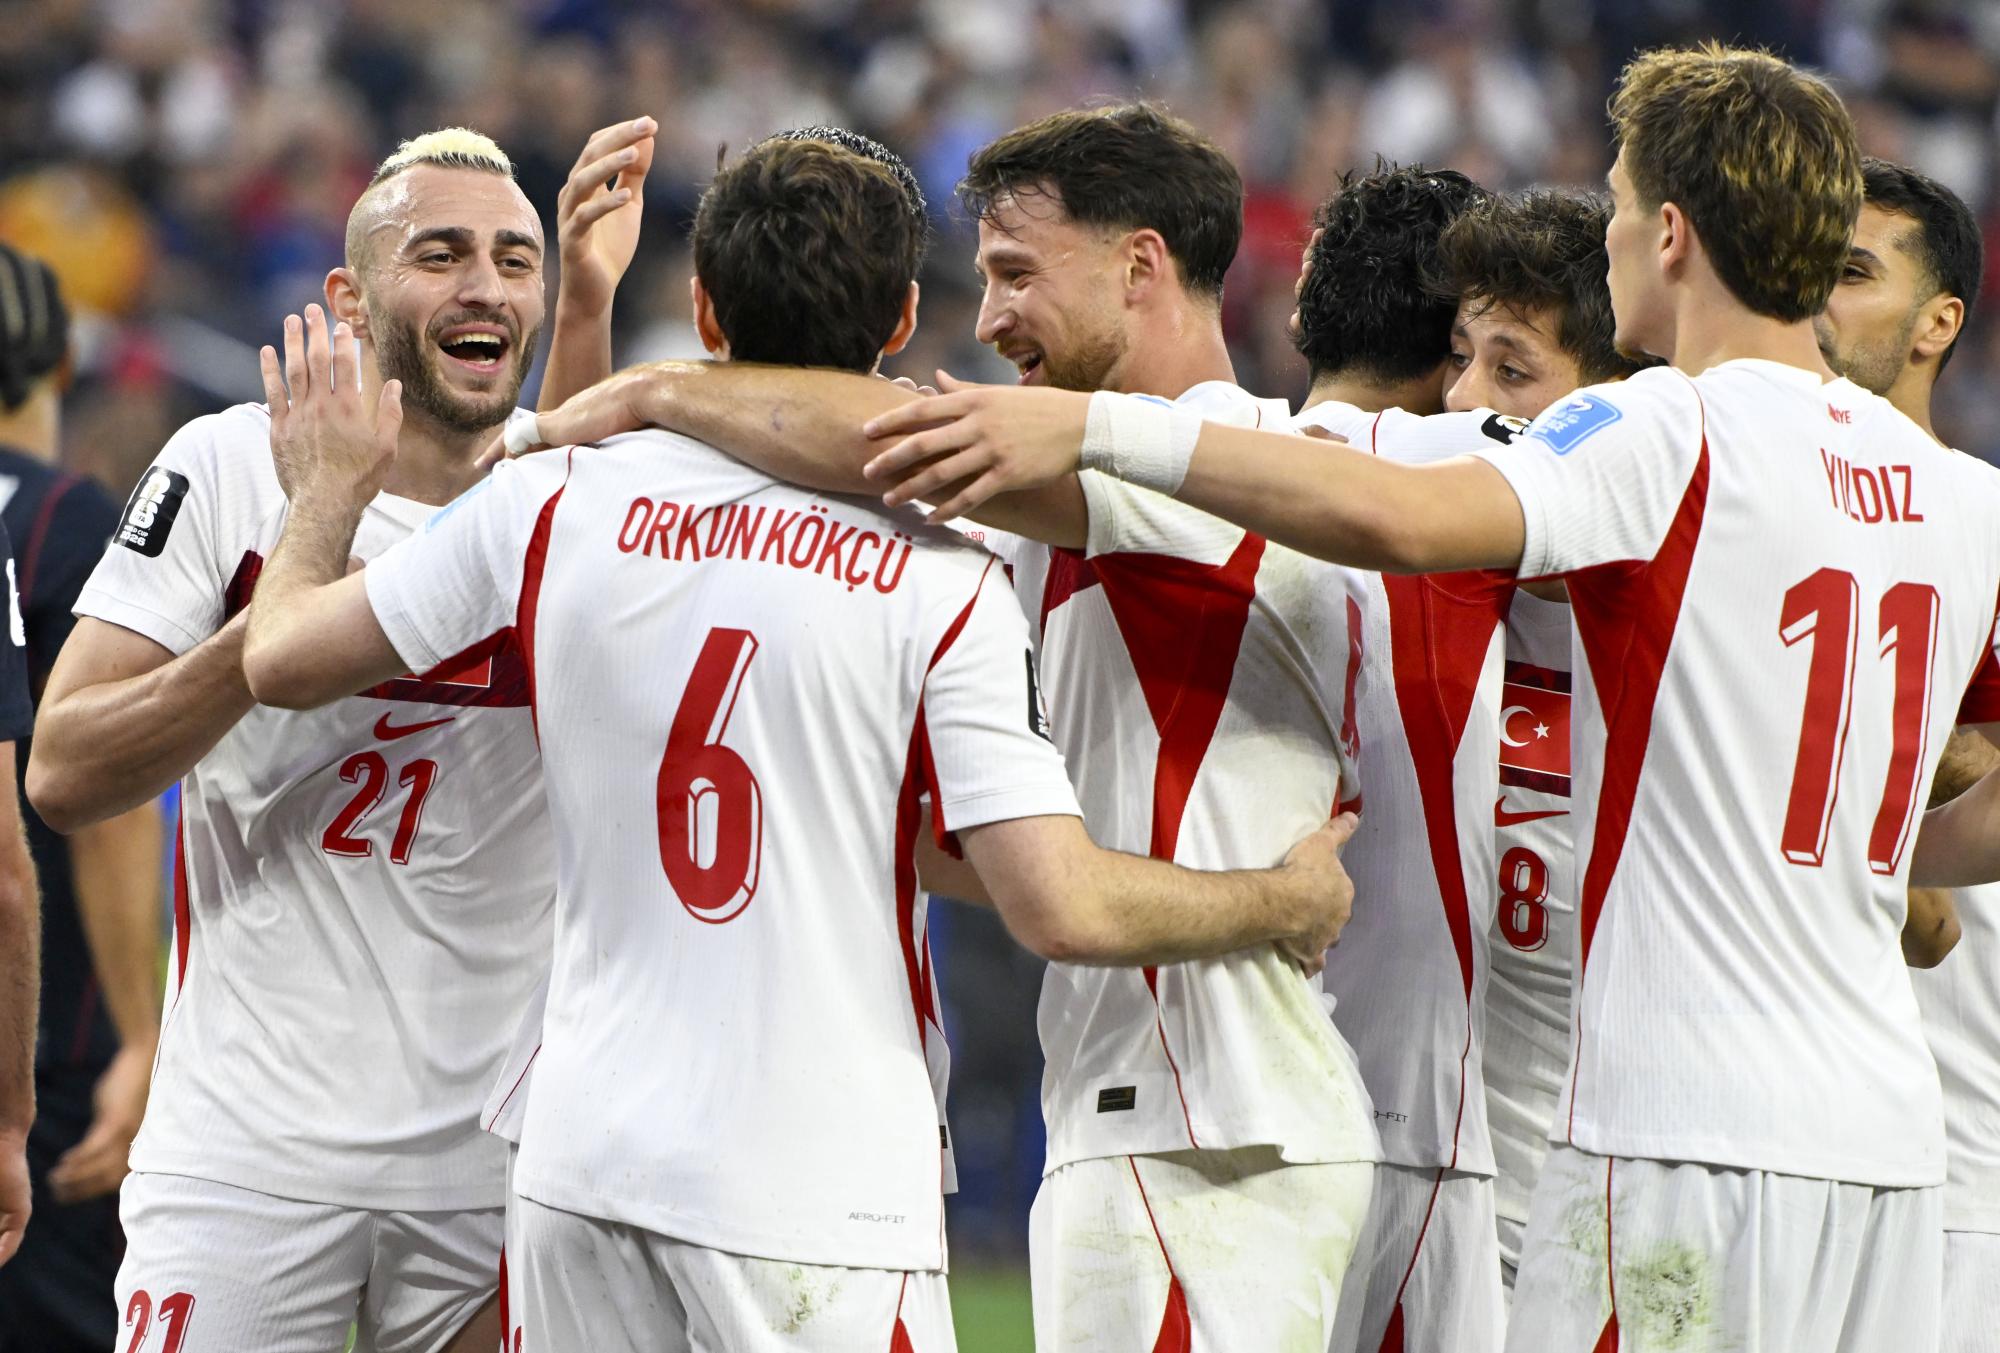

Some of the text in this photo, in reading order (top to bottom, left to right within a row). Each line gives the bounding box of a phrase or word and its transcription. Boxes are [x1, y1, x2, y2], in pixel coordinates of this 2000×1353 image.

[1820, 446, 1924, 524] YILDIZ
[617, 496, 913, 594] ORKUN KÖKÇÜ
[1779, 566, 1940, 877] 11
[321, 750, 439, 866] 21
[656, 626, 763, 924] 6
[1498, 846, 1550, 952] 8
[848, 1211, 907, 1224] AERO-FIT
